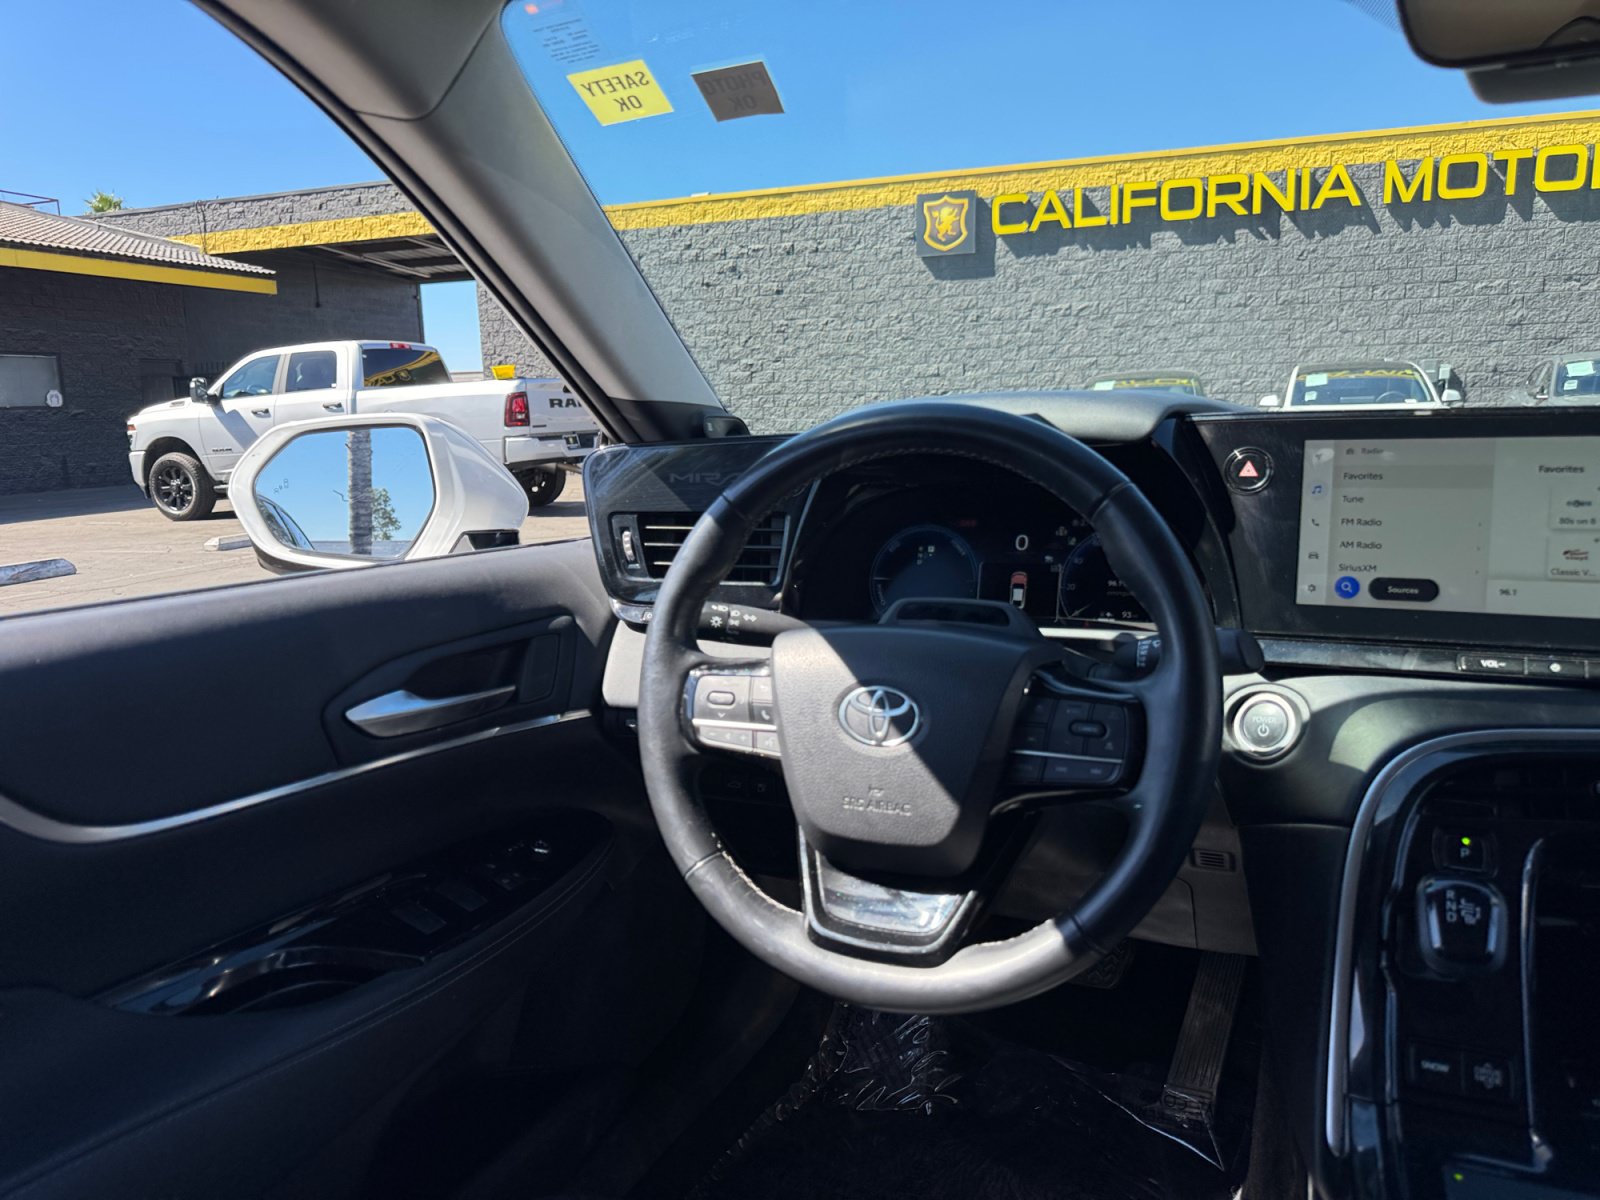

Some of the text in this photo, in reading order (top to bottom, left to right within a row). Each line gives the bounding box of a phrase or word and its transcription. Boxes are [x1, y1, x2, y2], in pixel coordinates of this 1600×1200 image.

[991, 164, 1362, 235] CALIFORNIA
[1538, 464, 1585, 474] Favorites
[1343, 472, 1383, 481] Favorites
[1342, 495, 1364, 504] Tune
[1341, 518, 1382, 526] FM Radio
[1015, 534, 1029, 551] 0
[1339, 541, 1382, 550] AM Radio
[1338, 563, 1377, 573] SiriusXM
[1551, 567, 1580, 576] Classic
[1387, 585, 1420, 595] Sources
